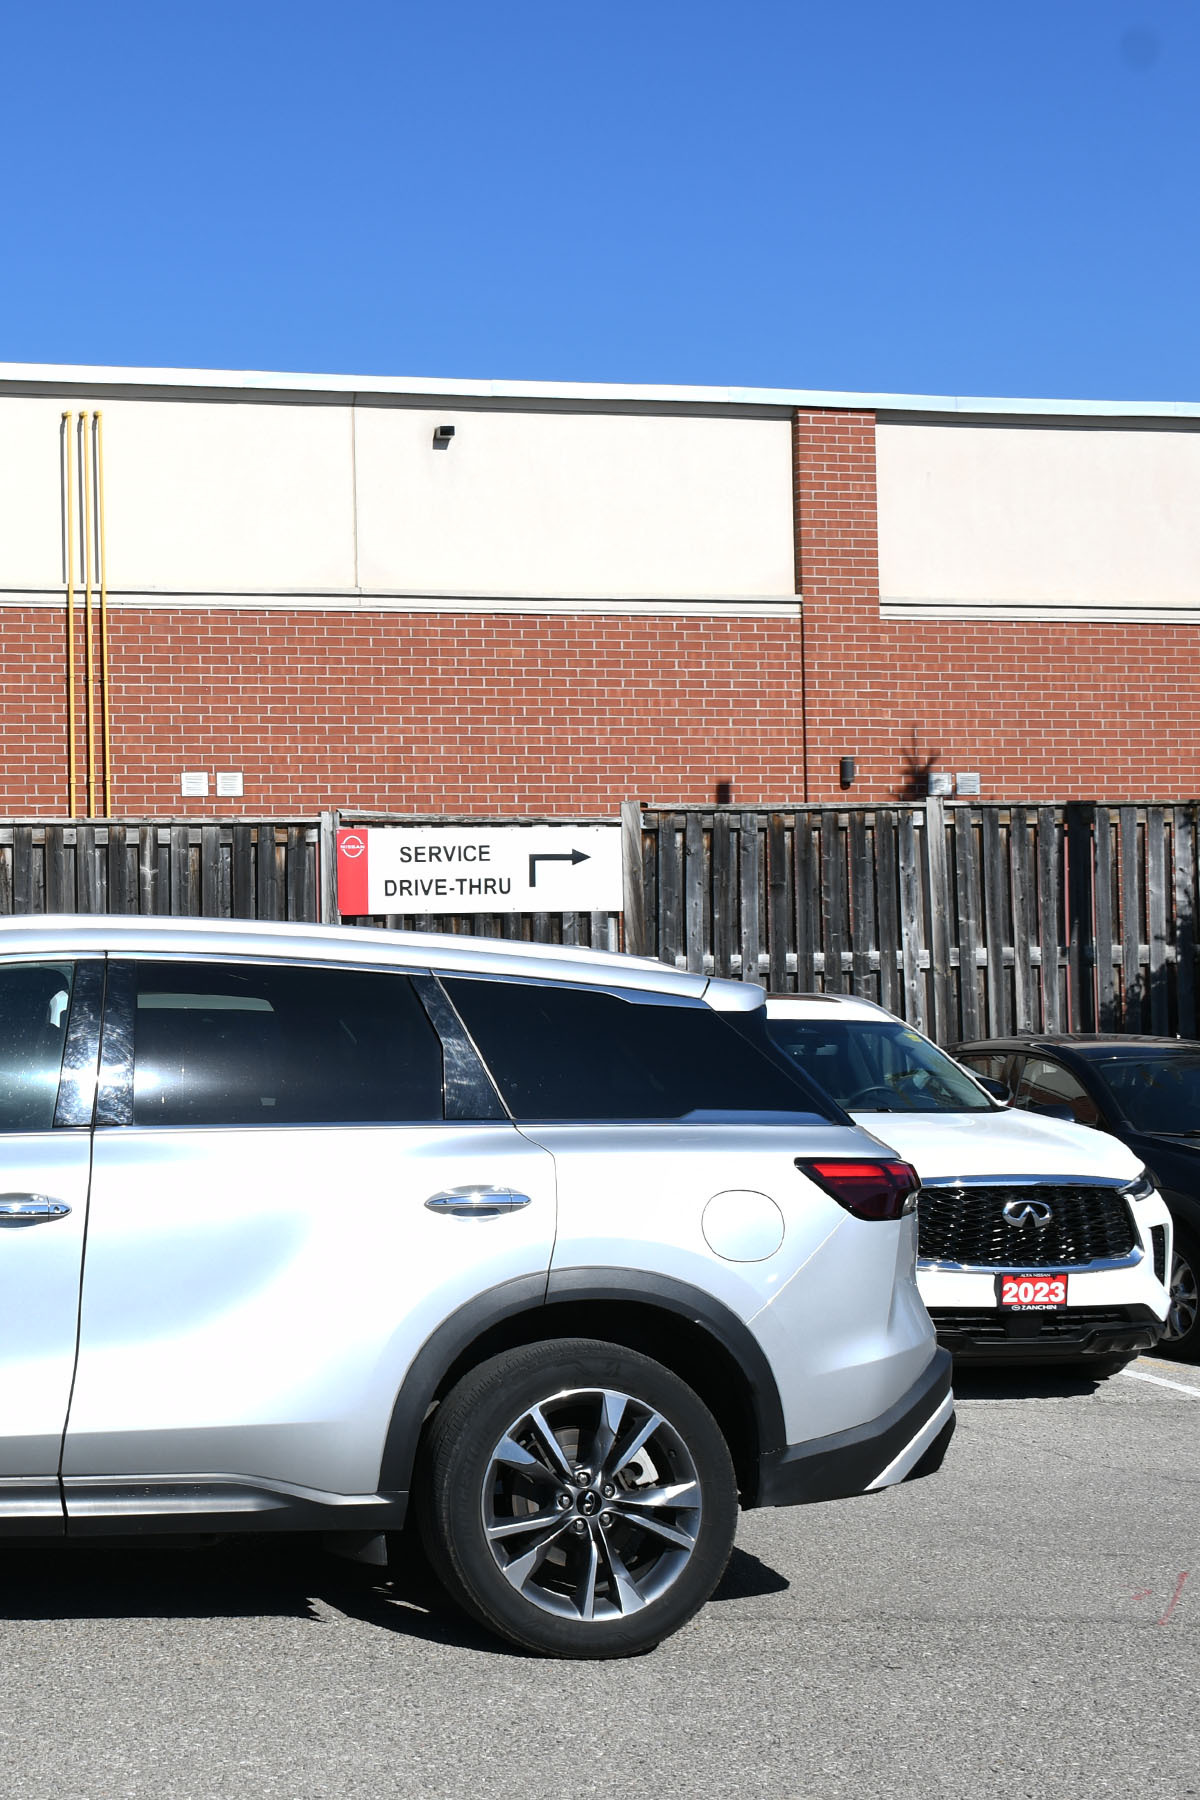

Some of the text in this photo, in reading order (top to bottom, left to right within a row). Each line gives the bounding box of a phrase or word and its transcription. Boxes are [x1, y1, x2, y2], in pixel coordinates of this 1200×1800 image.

[399, 844, 491, 863] SERVICE
[384, 877, 512, 897] DRIVE-THRU
[1002, 1281, 1066, 1303] 2023
